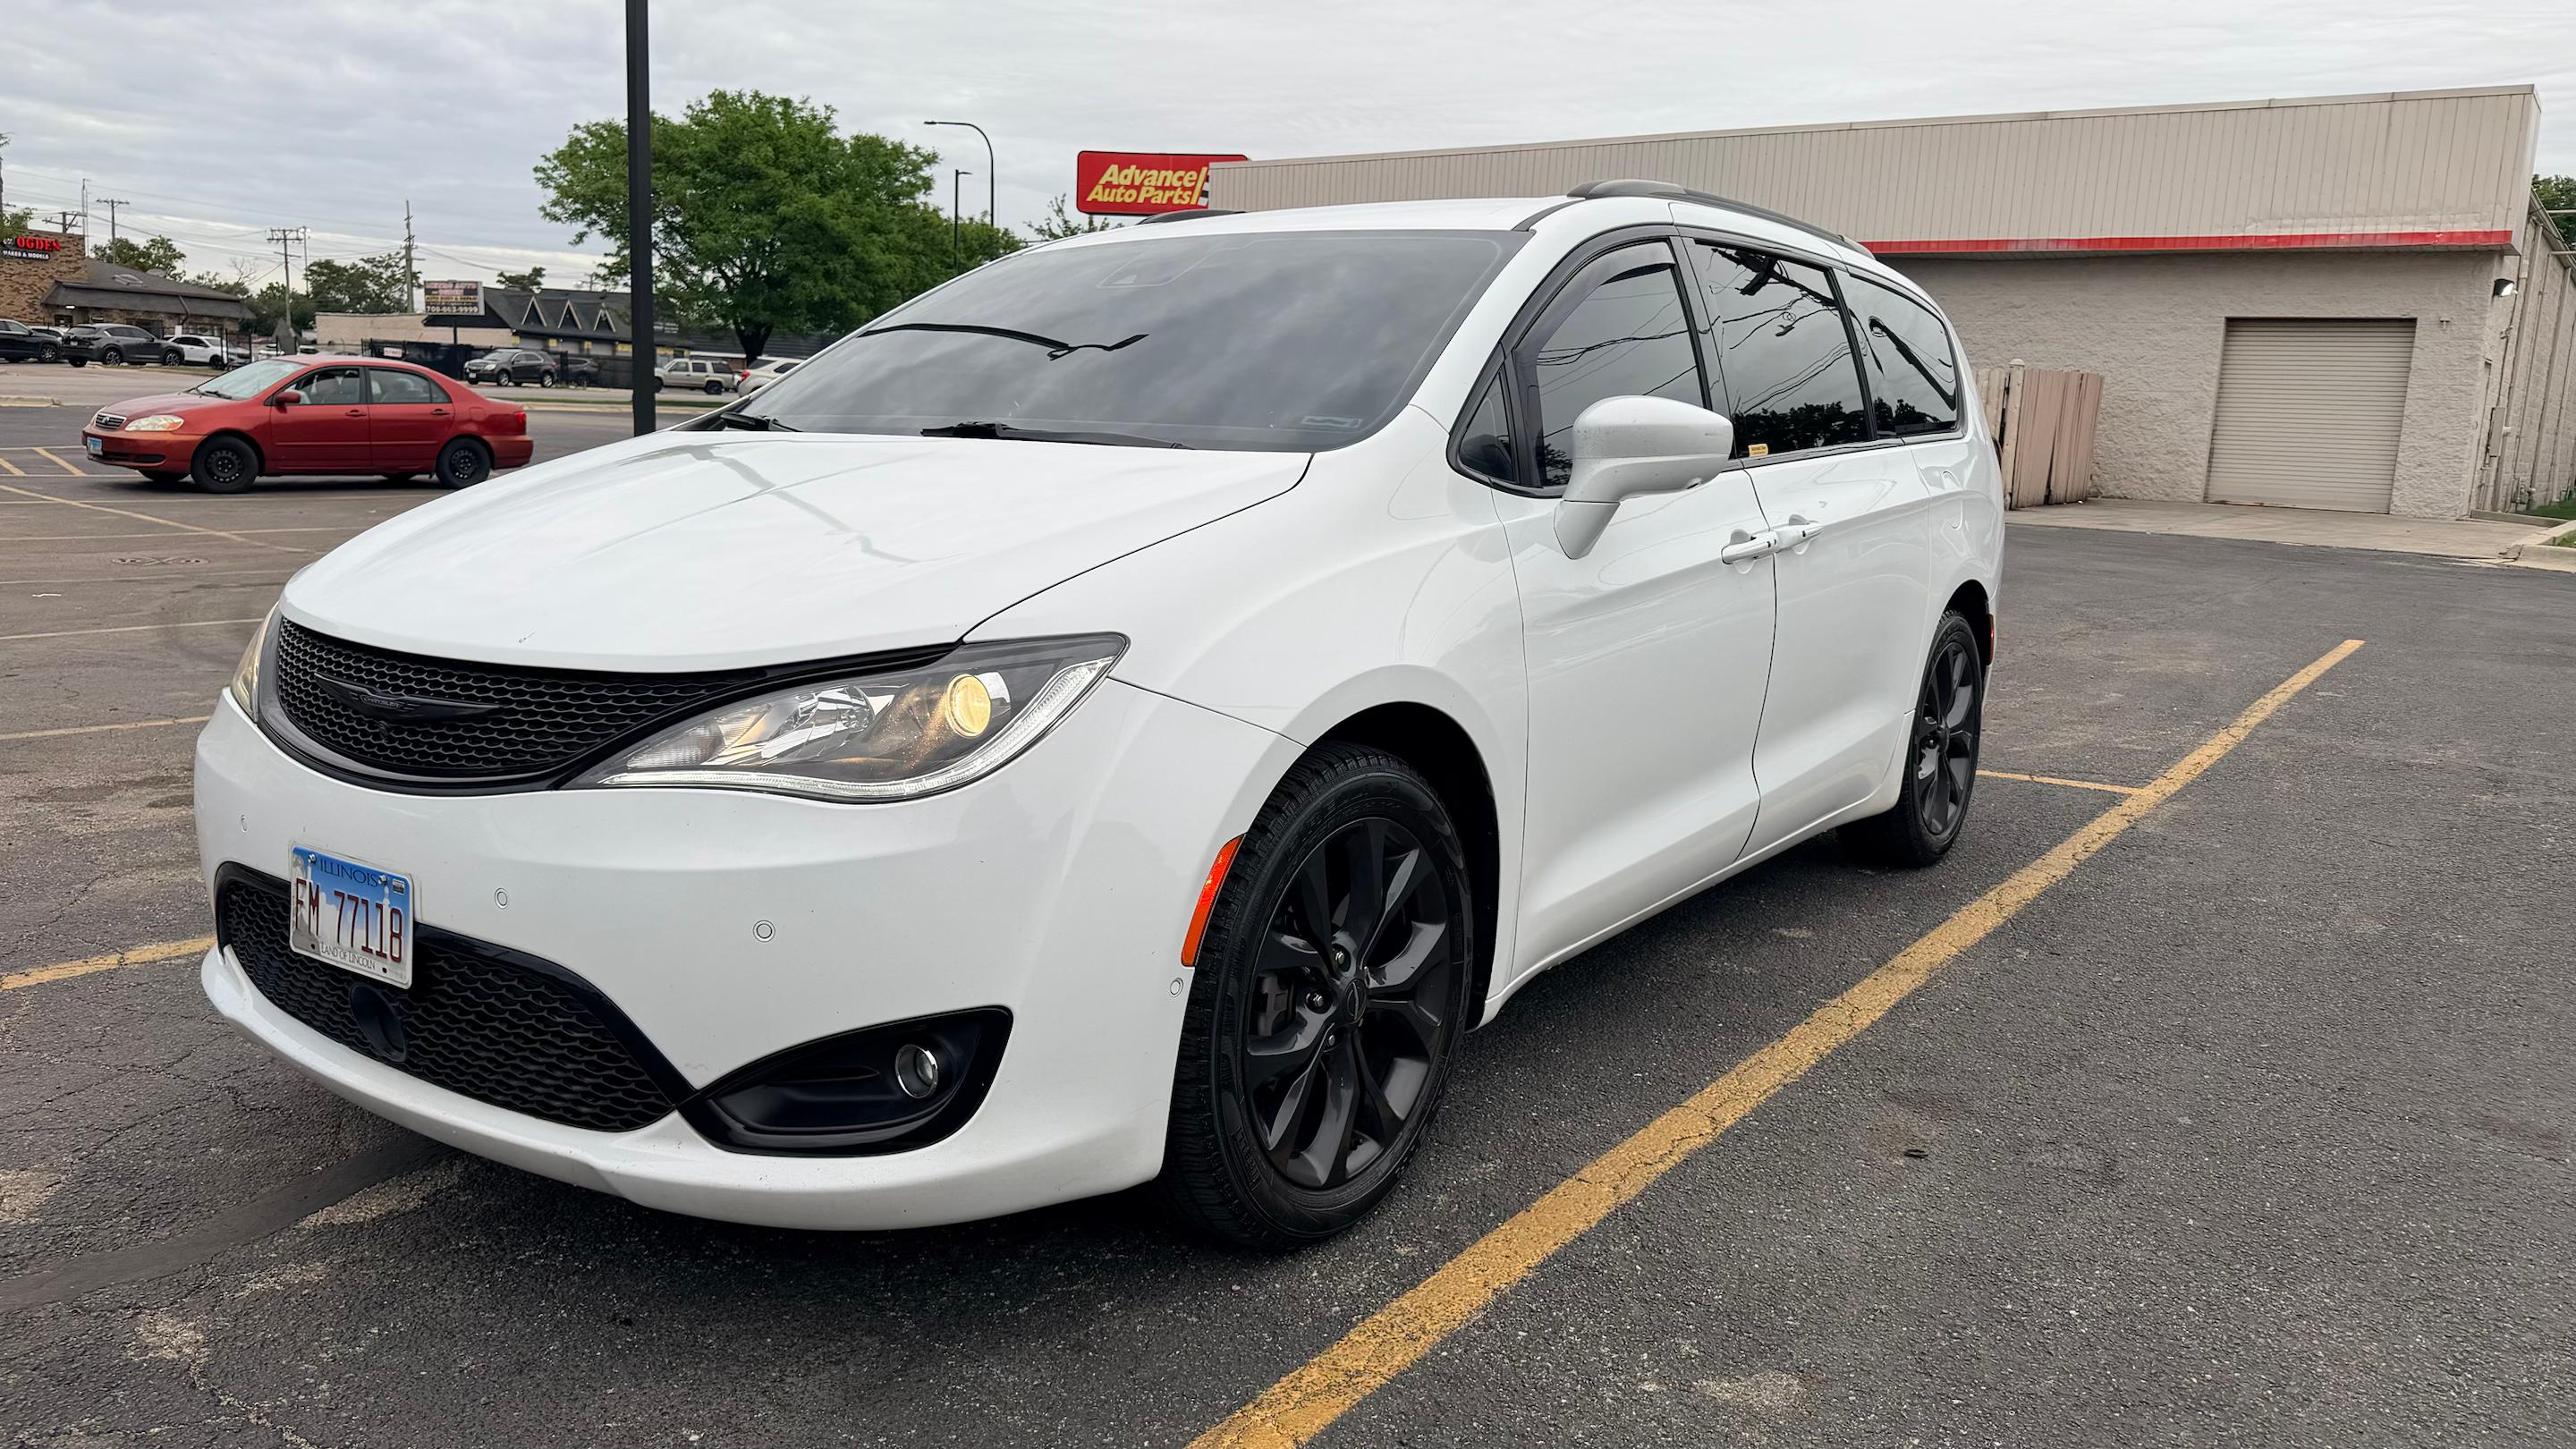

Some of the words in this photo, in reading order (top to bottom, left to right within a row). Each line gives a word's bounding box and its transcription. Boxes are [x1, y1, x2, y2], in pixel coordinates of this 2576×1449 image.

[1098, 164, 1198, 188] Advance
[1086, 185, 1139, 203] Auto
[1137, 185, 1193, 206] Parts
[16, 235, 62, 251] OGDEN
[320, 859, 379, 888] ILLINOIS
[295, 877, 320, 936] FM
[334, 890, 403, 963] 77118
[348, 951, 376, 970] LINCOLN
